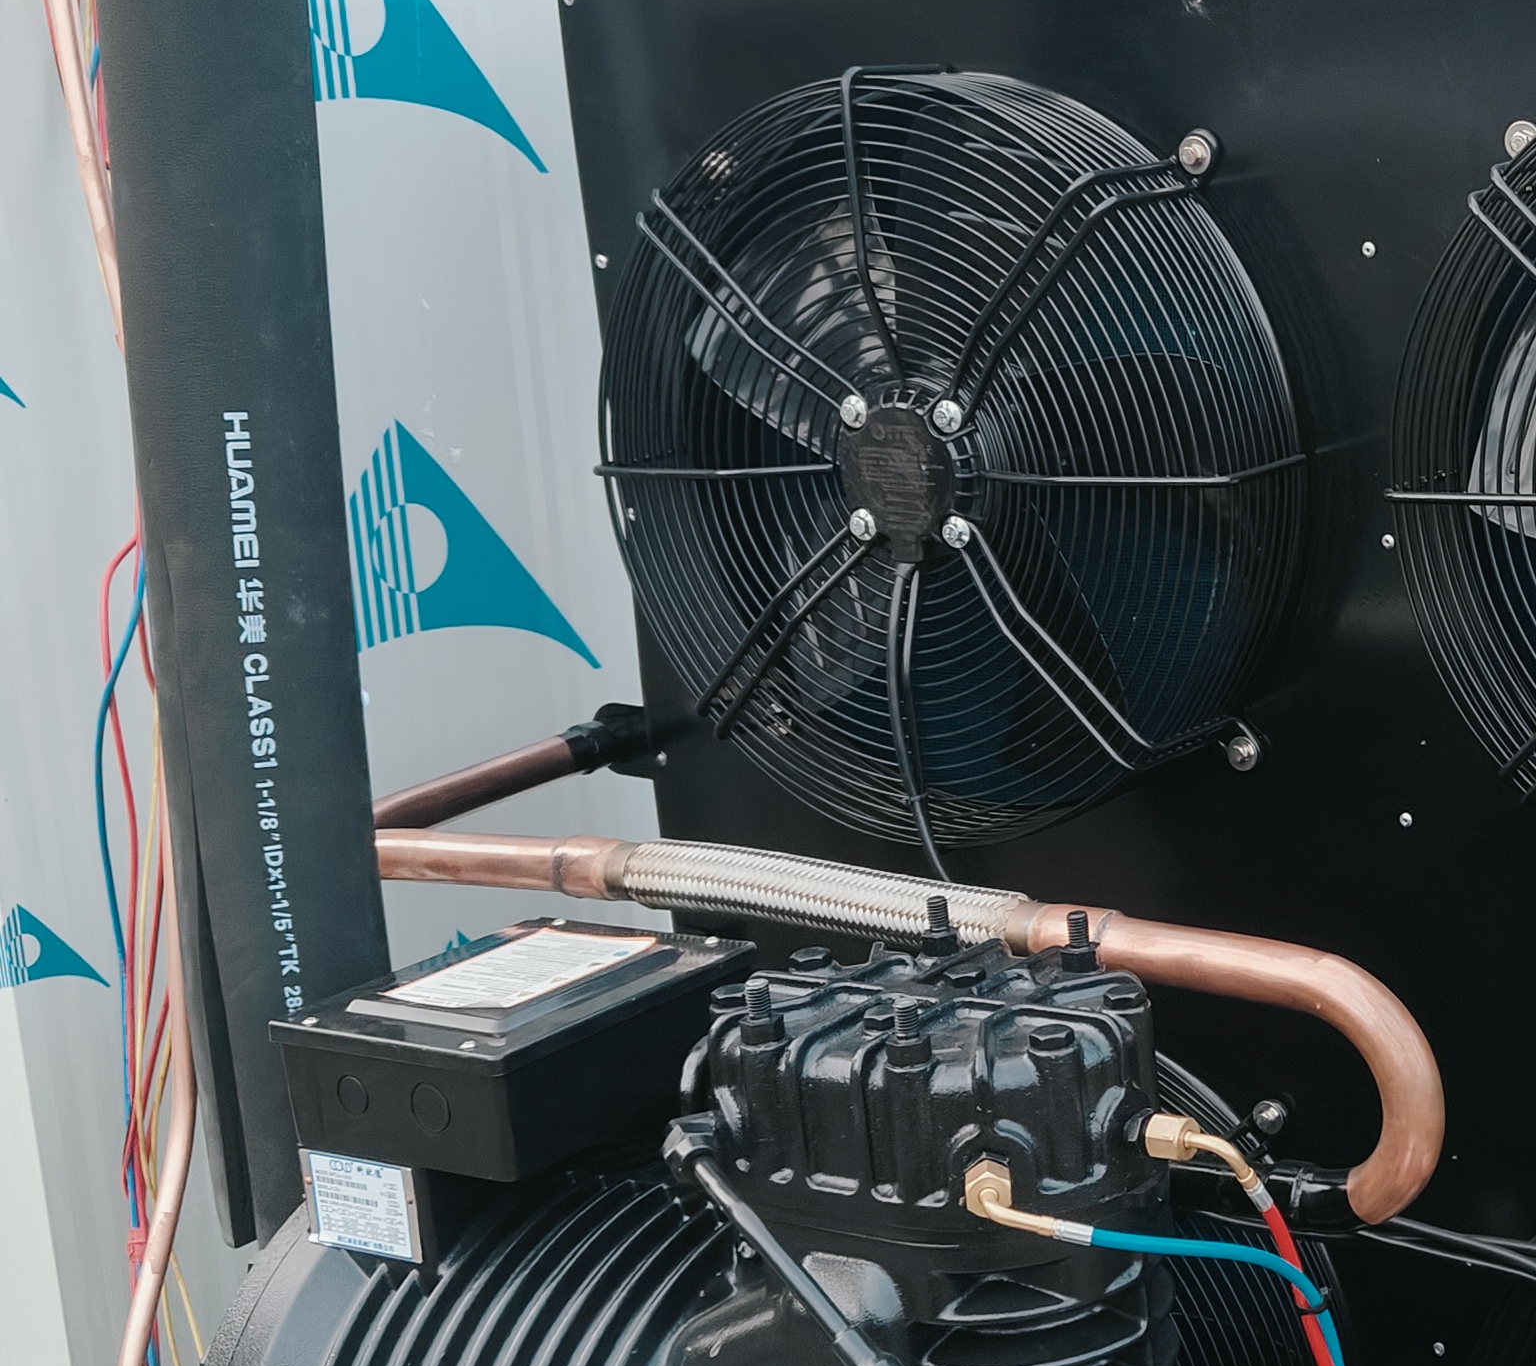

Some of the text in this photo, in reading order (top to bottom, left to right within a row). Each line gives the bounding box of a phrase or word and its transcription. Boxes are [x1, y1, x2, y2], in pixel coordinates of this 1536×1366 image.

[223, 411, 260, 568] HUAMEI
[236, 577, 268, 644] 华美
[243, 653, 279, 769] CLASS1
